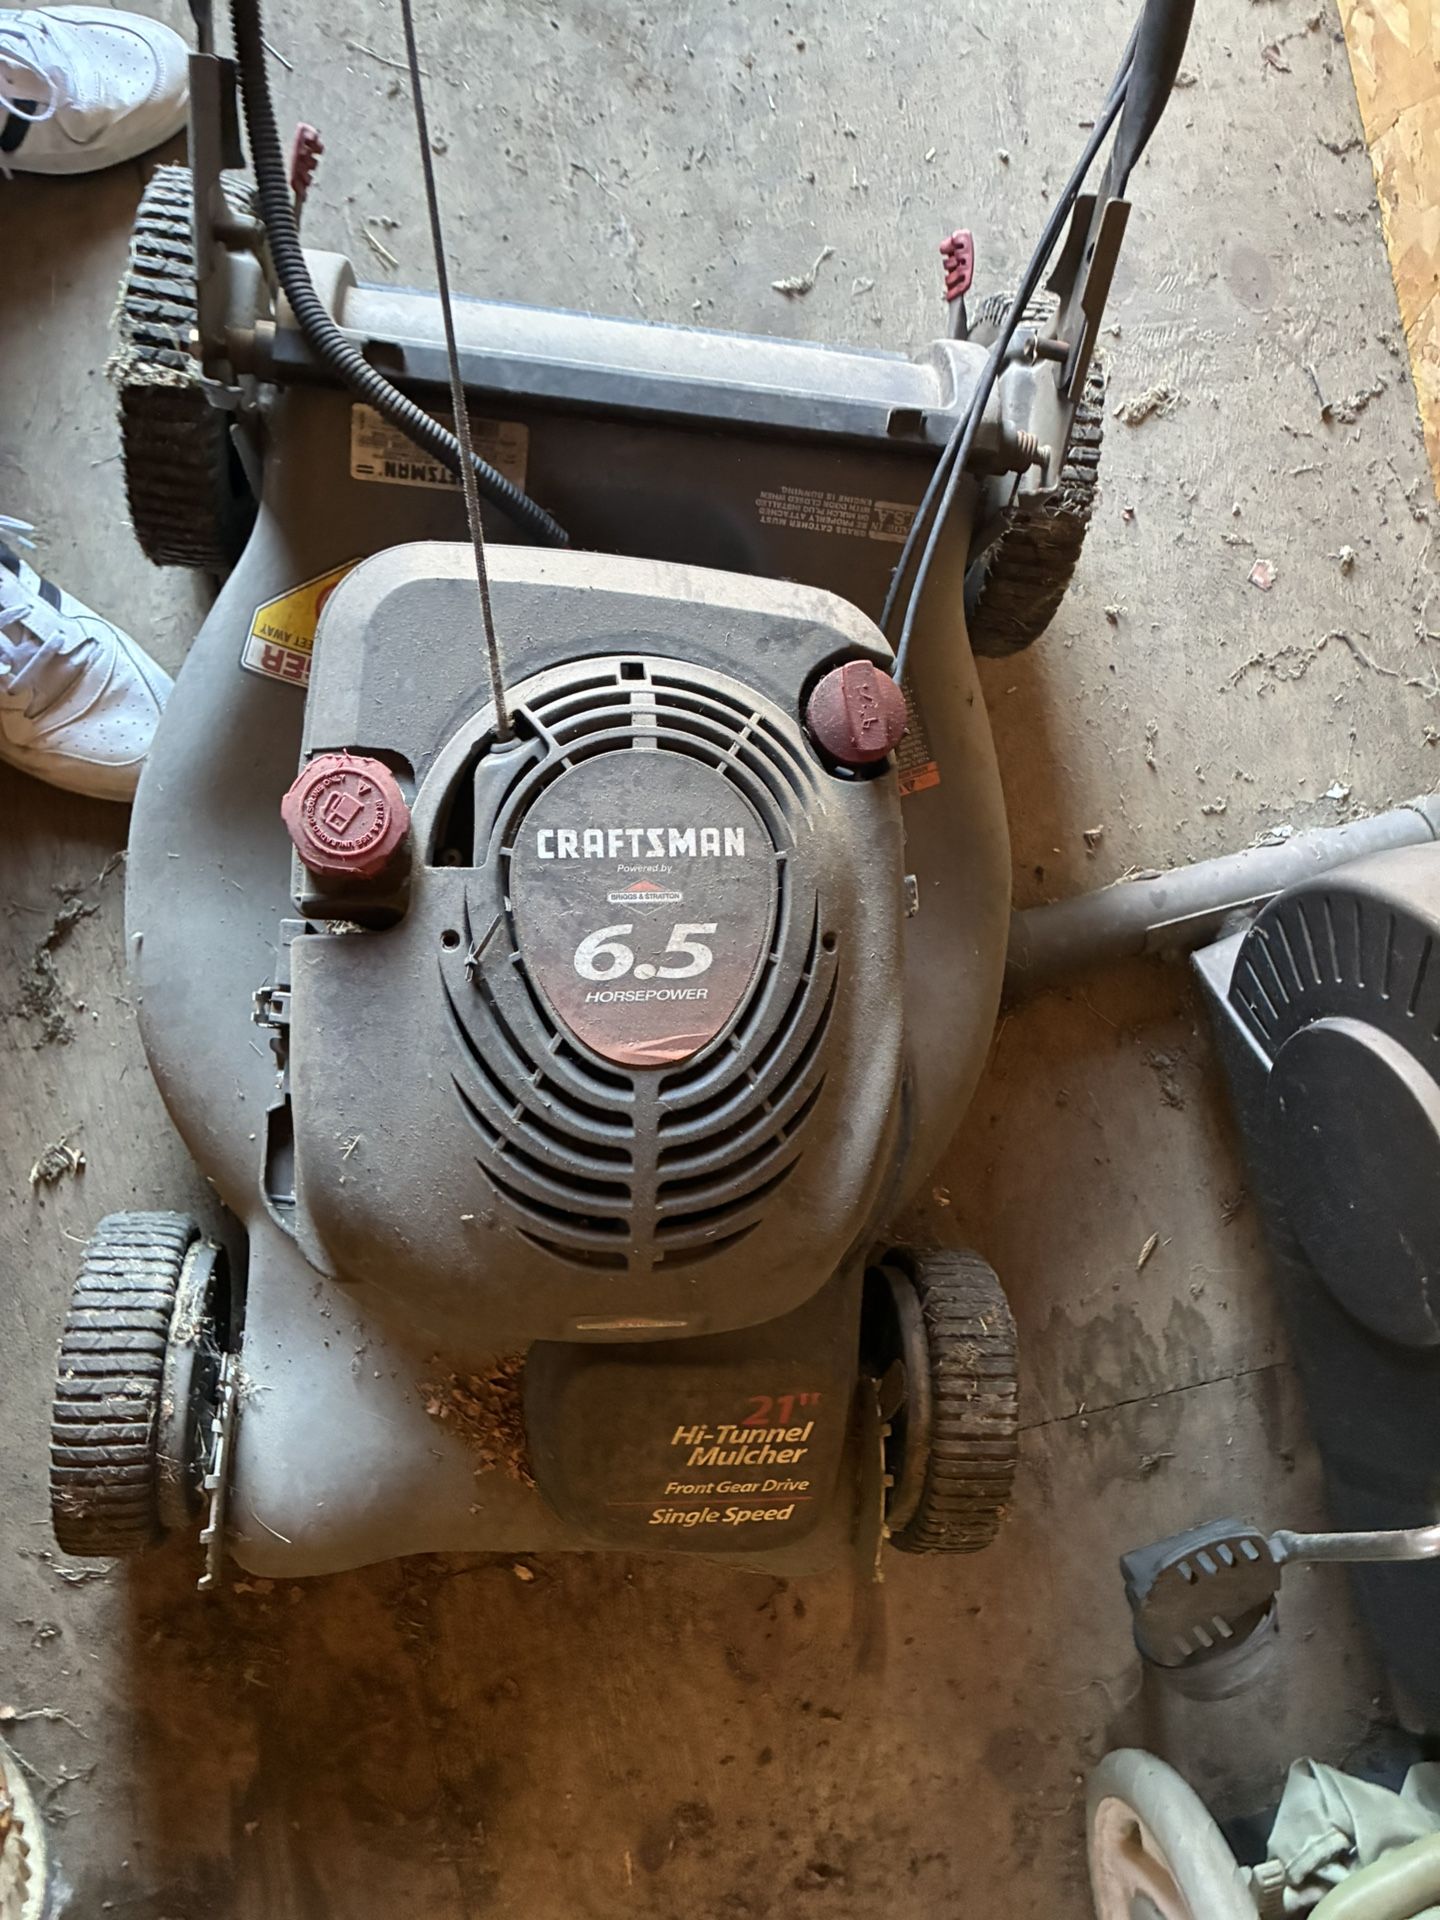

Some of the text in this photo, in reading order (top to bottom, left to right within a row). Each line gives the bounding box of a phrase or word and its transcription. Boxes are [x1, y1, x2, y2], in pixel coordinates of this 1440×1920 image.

[755, 498, 801, 512] INSTALLED
[787, 495, 822, 506] CLOSED
[758, 507, 807, 520] ATTACHED
[802, 505, 825, 515] PLUG
[826, 508, 856, 520] MULCH
[760, 515, 787, 526] MUST
[789, 519, 833, 533] CATCHER
[808, 514, 854, 528] PROPERLY
[261, 624, 292, 642] AWAY
[261, 644, 311, 680] ER
[536, 827, 745, 859] CRAFTSMAN
[617, 863, 673, 874] Powered by
[645, 892, 680, 900] STRATTON
[573, 922, 718, 981] 6.5
[585, 988, 708, 1003] HORSEPOWER
[742, 1392, 822, 1425] 21"
[671, 1421, 814, 1445] Hi-Tunnel
[687, 1444, 808, 1467] Mulcher
[664, 1478, 810, 1495] Front Gear Drive
[648, 1504, 795, 1527] Single Speed
